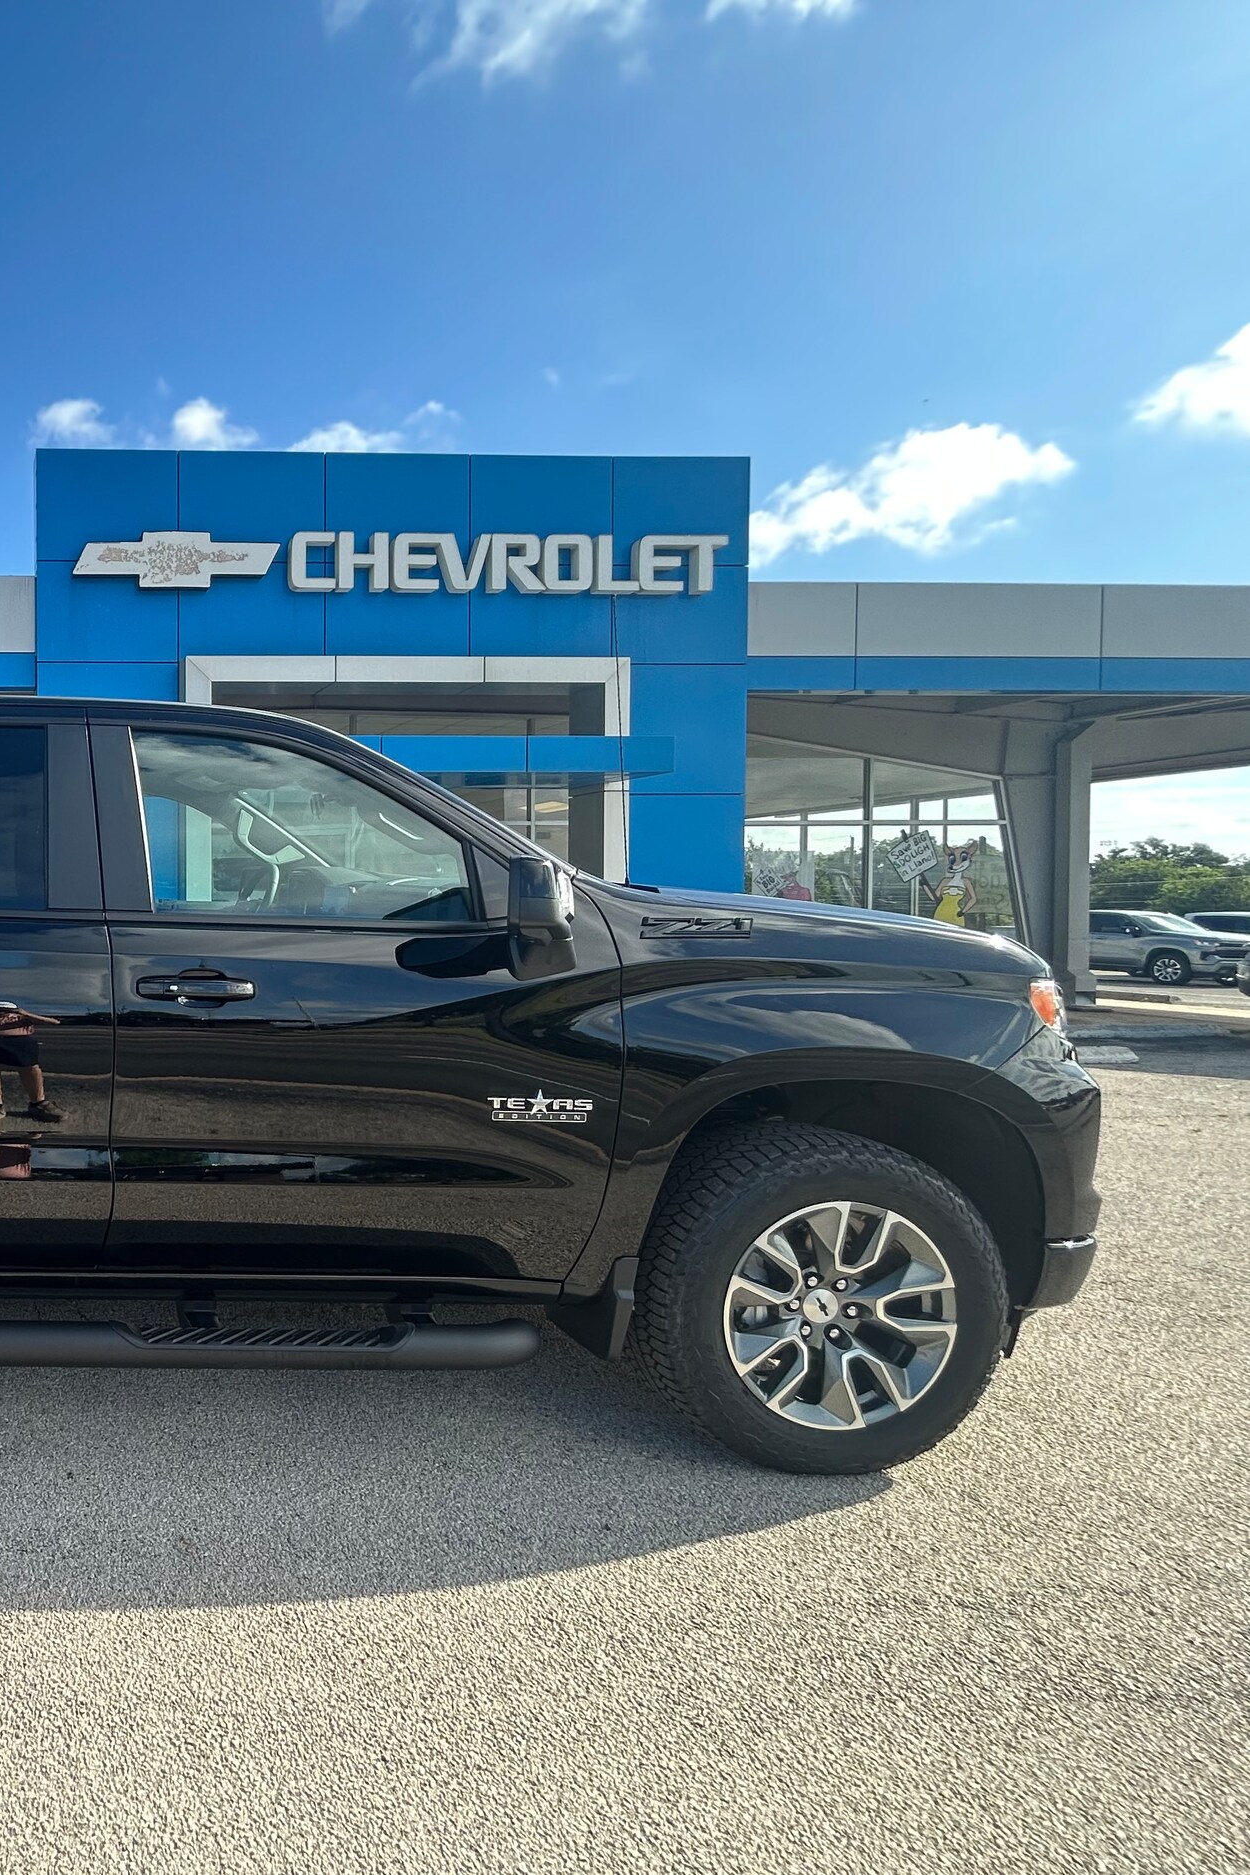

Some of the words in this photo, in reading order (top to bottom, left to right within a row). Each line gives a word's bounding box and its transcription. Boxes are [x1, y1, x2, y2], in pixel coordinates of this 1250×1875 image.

[288, 531, 729, 595] CHEVROLET
[891, 843, 912, 860] Save
[912, 833, 927, 847] BIG
[908, 850, 935, 871] Llano!
[761, 875, 776, 889] BIG
[639, 917, 754, 940] Z71
[498, 1112, 582, 1121] EDITION
